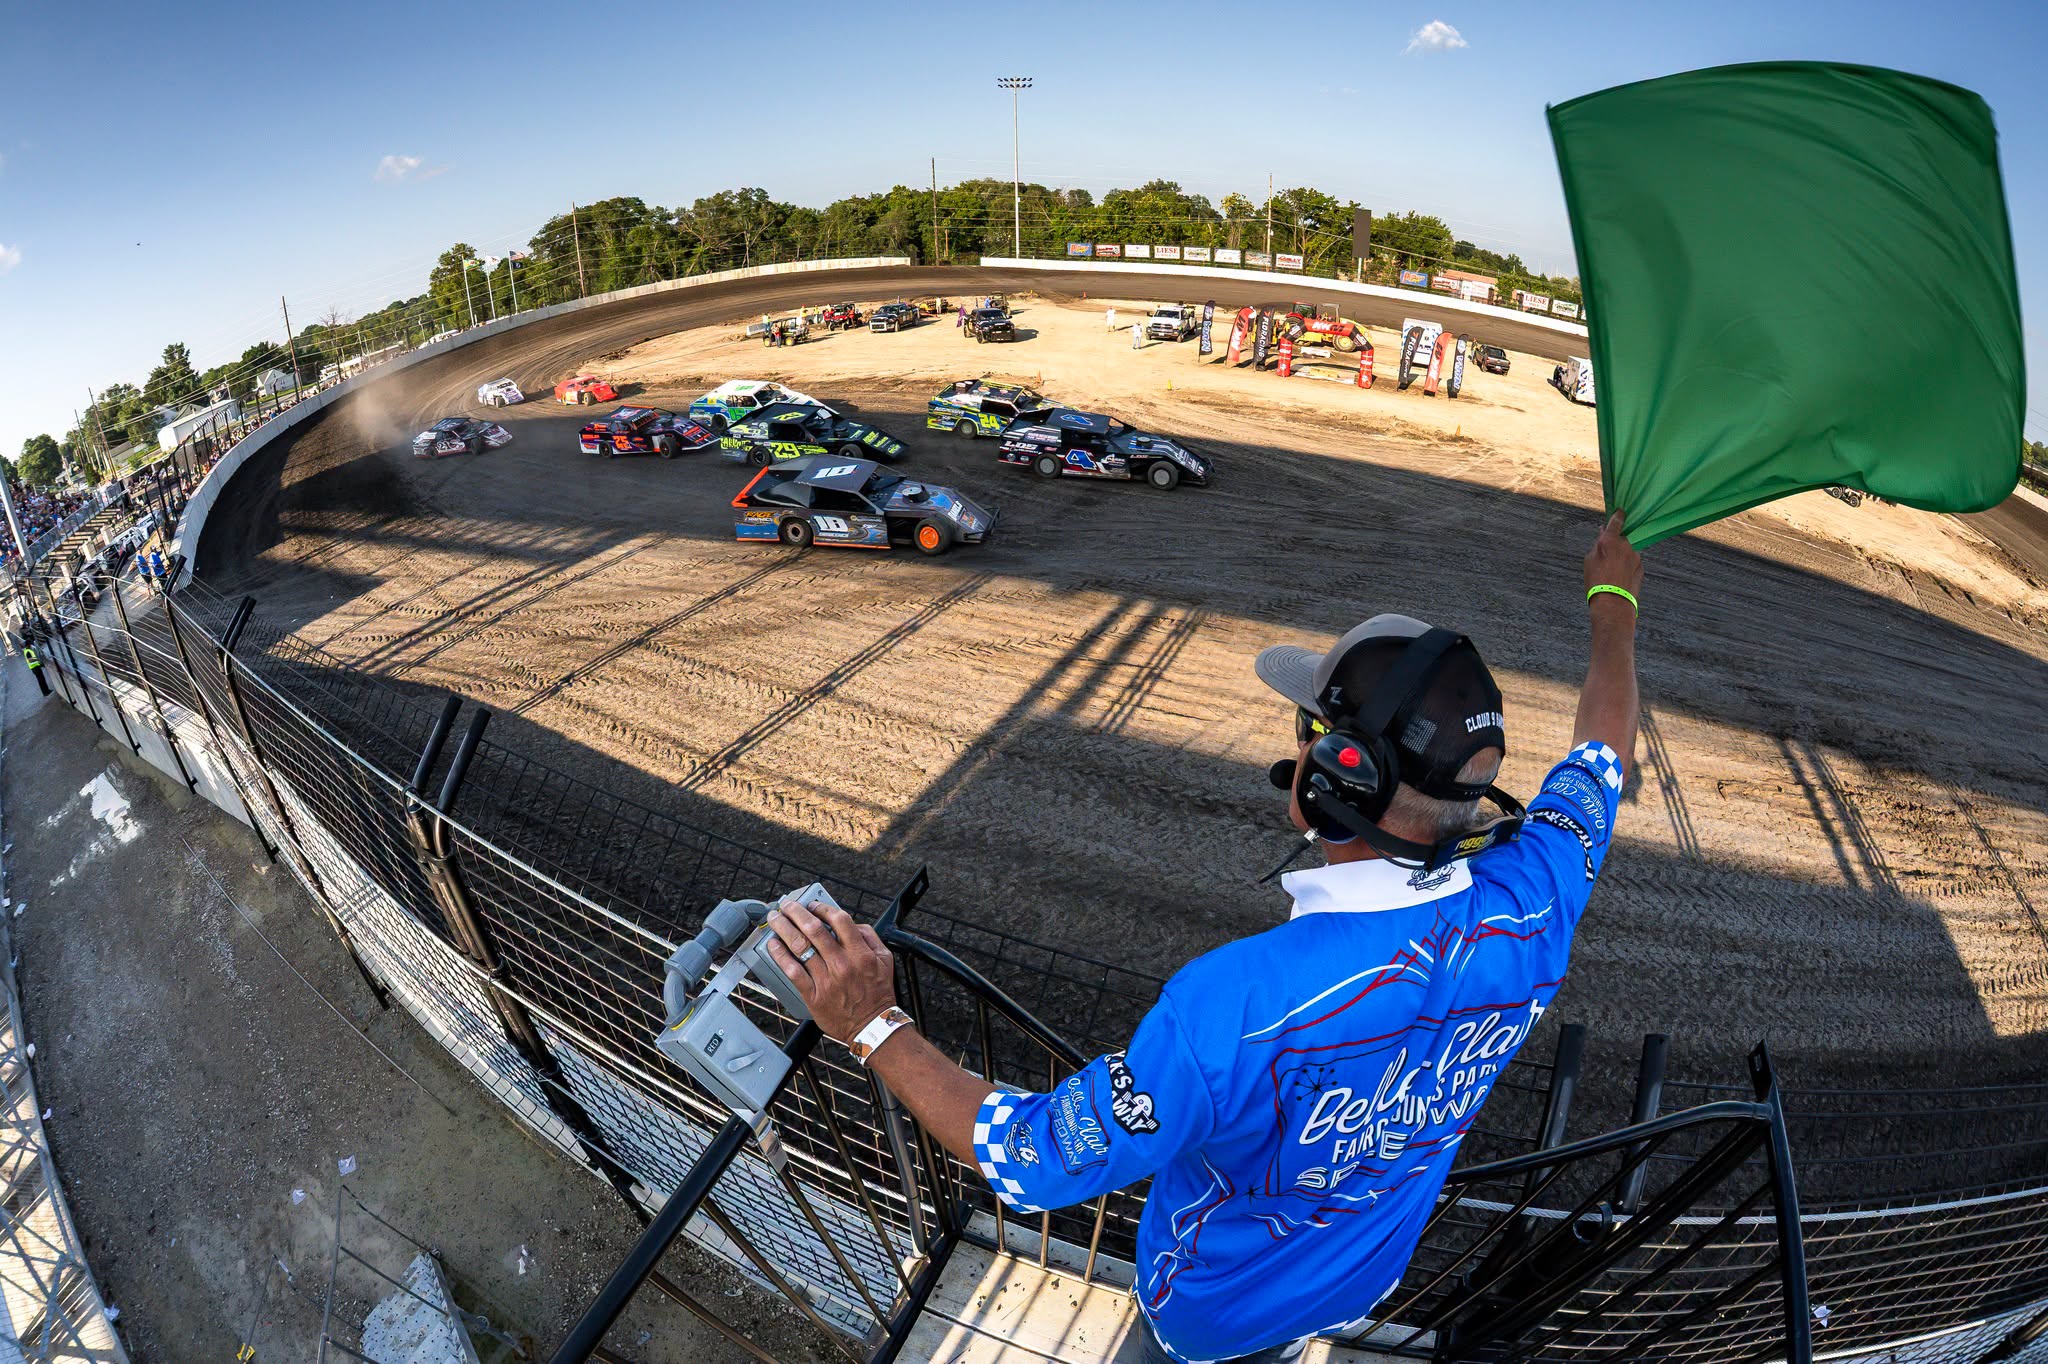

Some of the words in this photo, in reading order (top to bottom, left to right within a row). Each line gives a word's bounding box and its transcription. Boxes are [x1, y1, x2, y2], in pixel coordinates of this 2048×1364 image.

[1525, 295, 1546, 305] LIESE
[1258, 316, 1268, 358] FLORACING
[769, 441, 801, 459] 29
[812, 464, 857, 479] 18
[812, 515, 849, 532] 18
[1465, 712, 1490, 733] CLOUD
[1491, 711, 1496, 726] 9
[707, 1038, 719, 1054] RED
